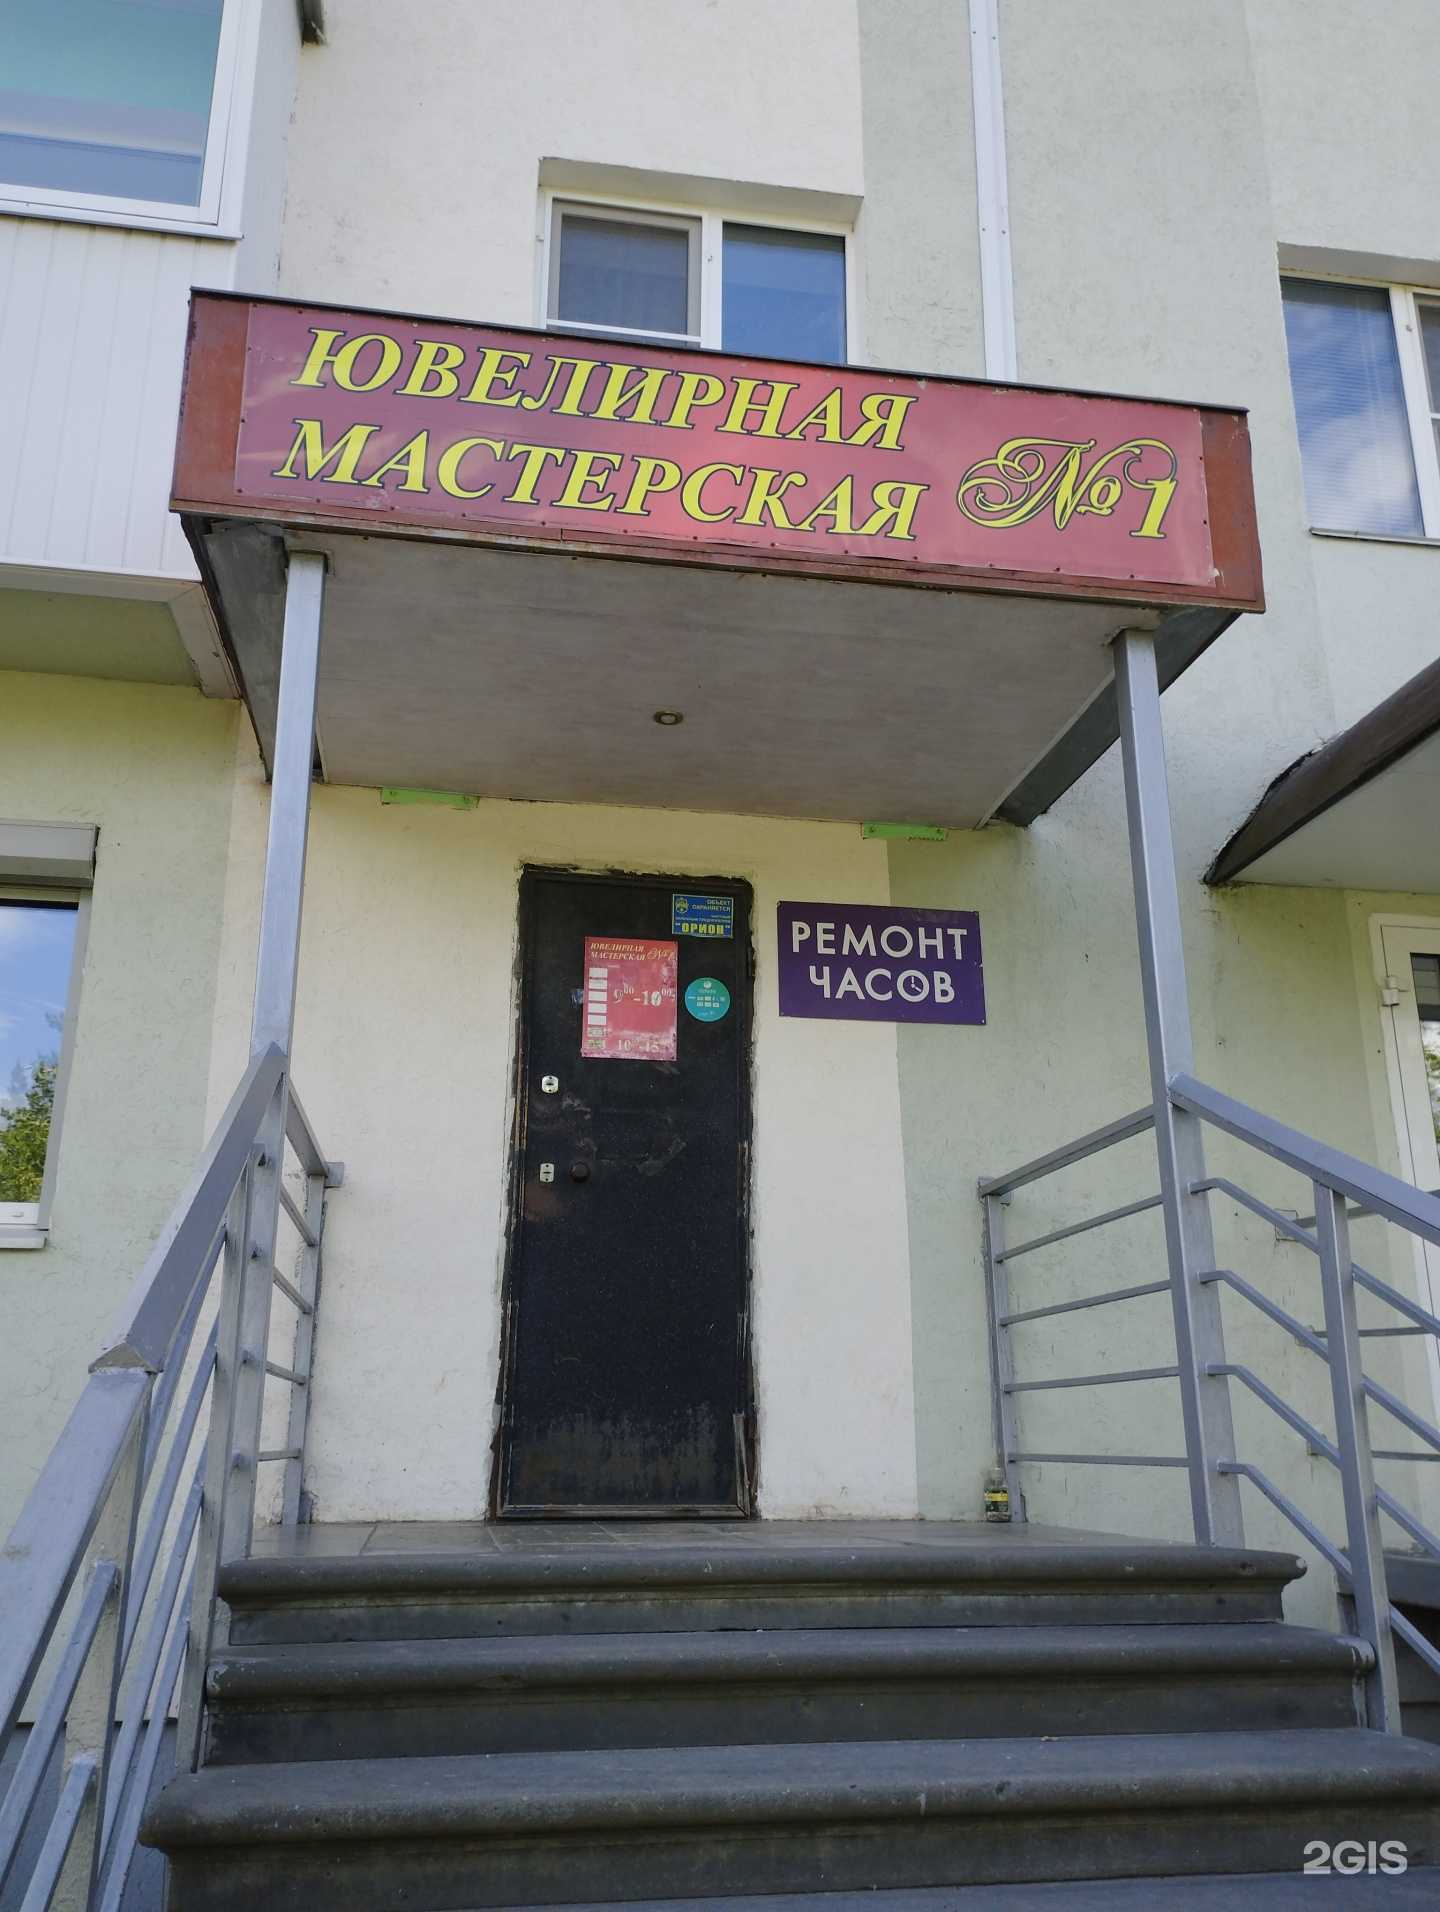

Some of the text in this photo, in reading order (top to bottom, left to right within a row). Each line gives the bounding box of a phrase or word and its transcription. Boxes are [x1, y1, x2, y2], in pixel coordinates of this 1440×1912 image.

[290, 328, 919, 451] ЮВЕЛИРНАЯ
[273, 418, 930, 541] МАСТЕРСКАЯ
[590, 942, 645, 953] ЮВЕЛИРНАЯ
[591, 951, 647, 961] МАСТЕРСКАЯ
[792, 921, 967, 960] РЕМОНТ
[809, 965, 955, 1003] ЧАСОВ
